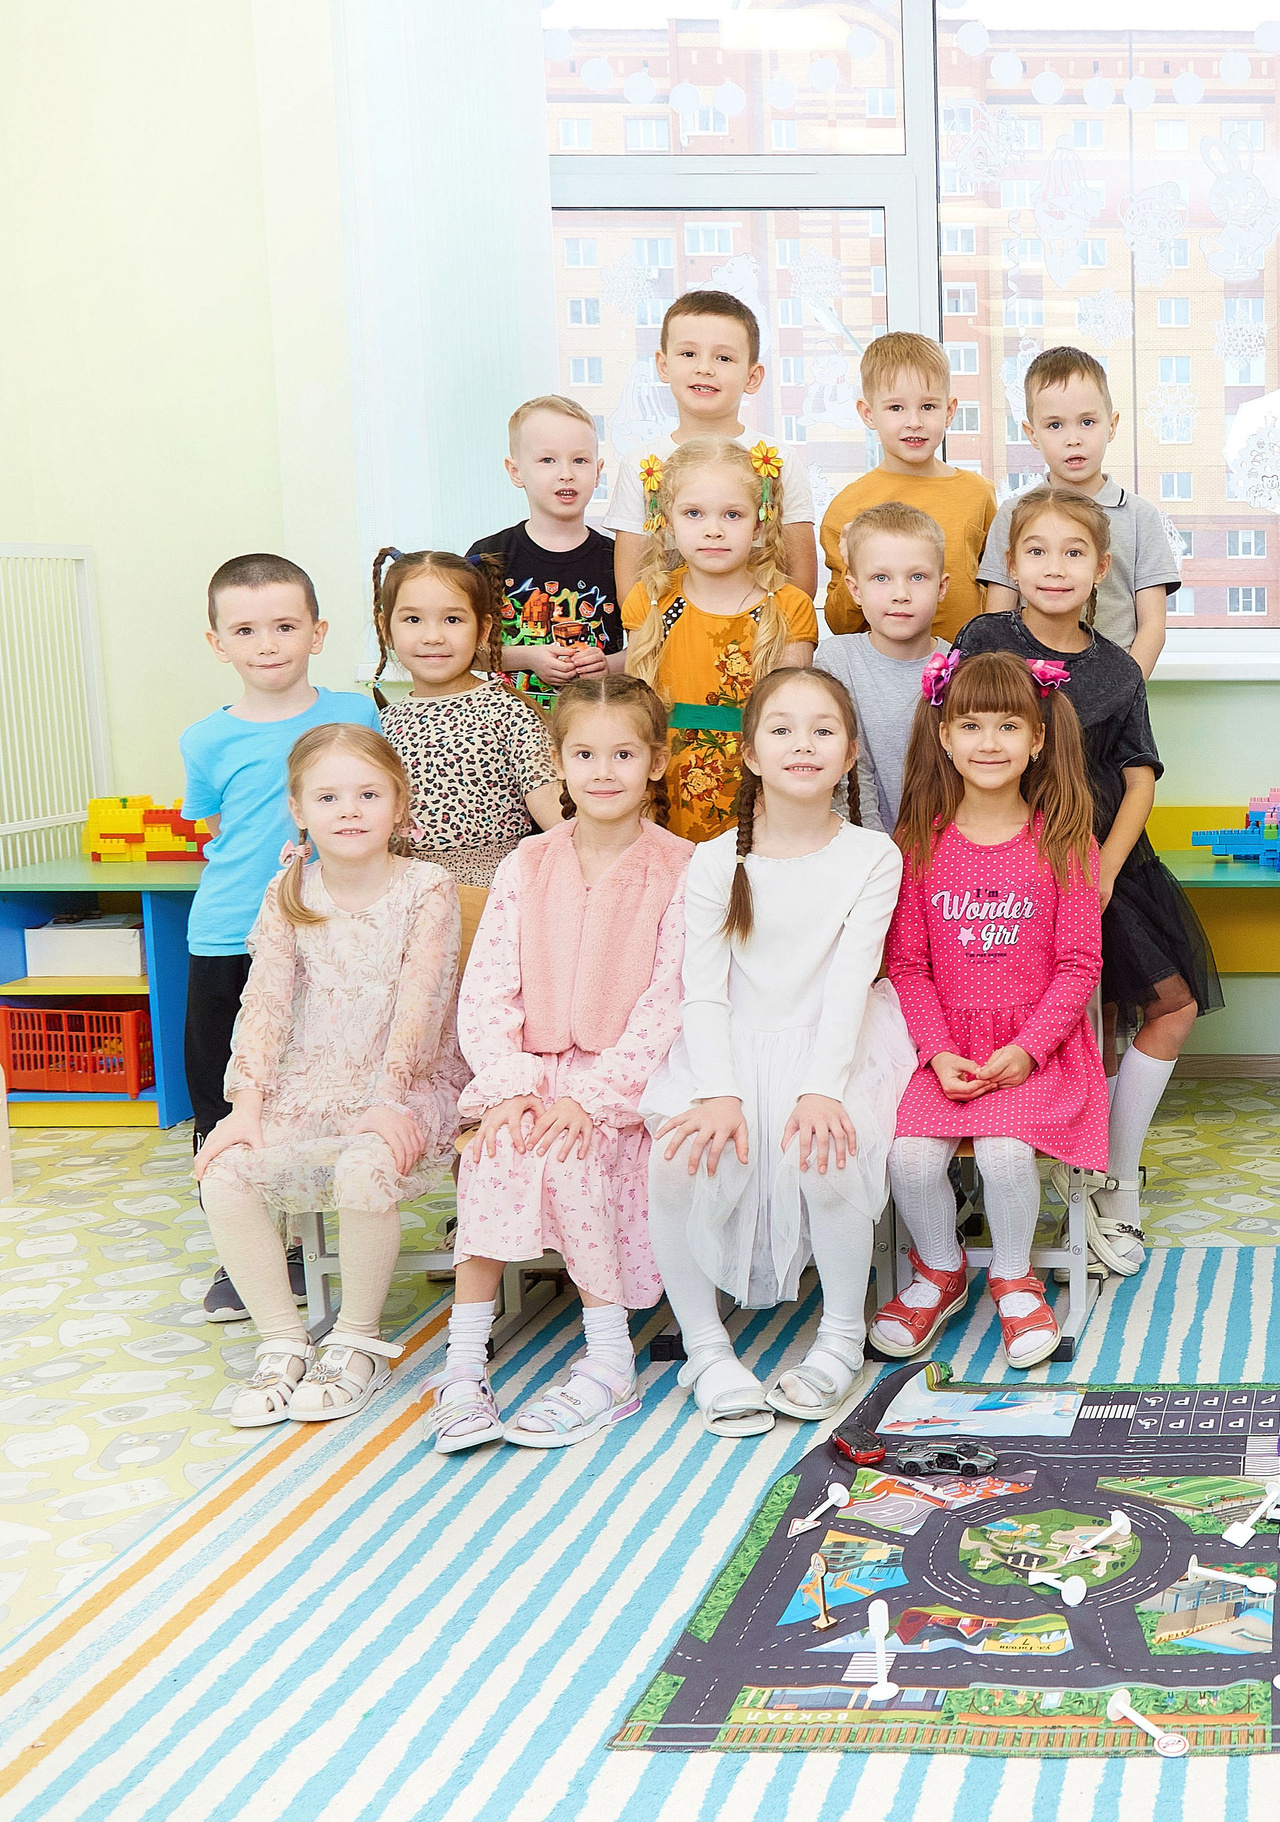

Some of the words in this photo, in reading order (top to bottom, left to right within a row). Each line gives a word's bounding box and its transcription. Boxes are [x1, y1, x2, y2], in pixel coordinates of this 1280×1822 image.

[931, 890, 1037, 921] Wonder
[981, 923, 1020, 952] Girl
[745, 1711, 849, 1721] ВОКЗАЛ
